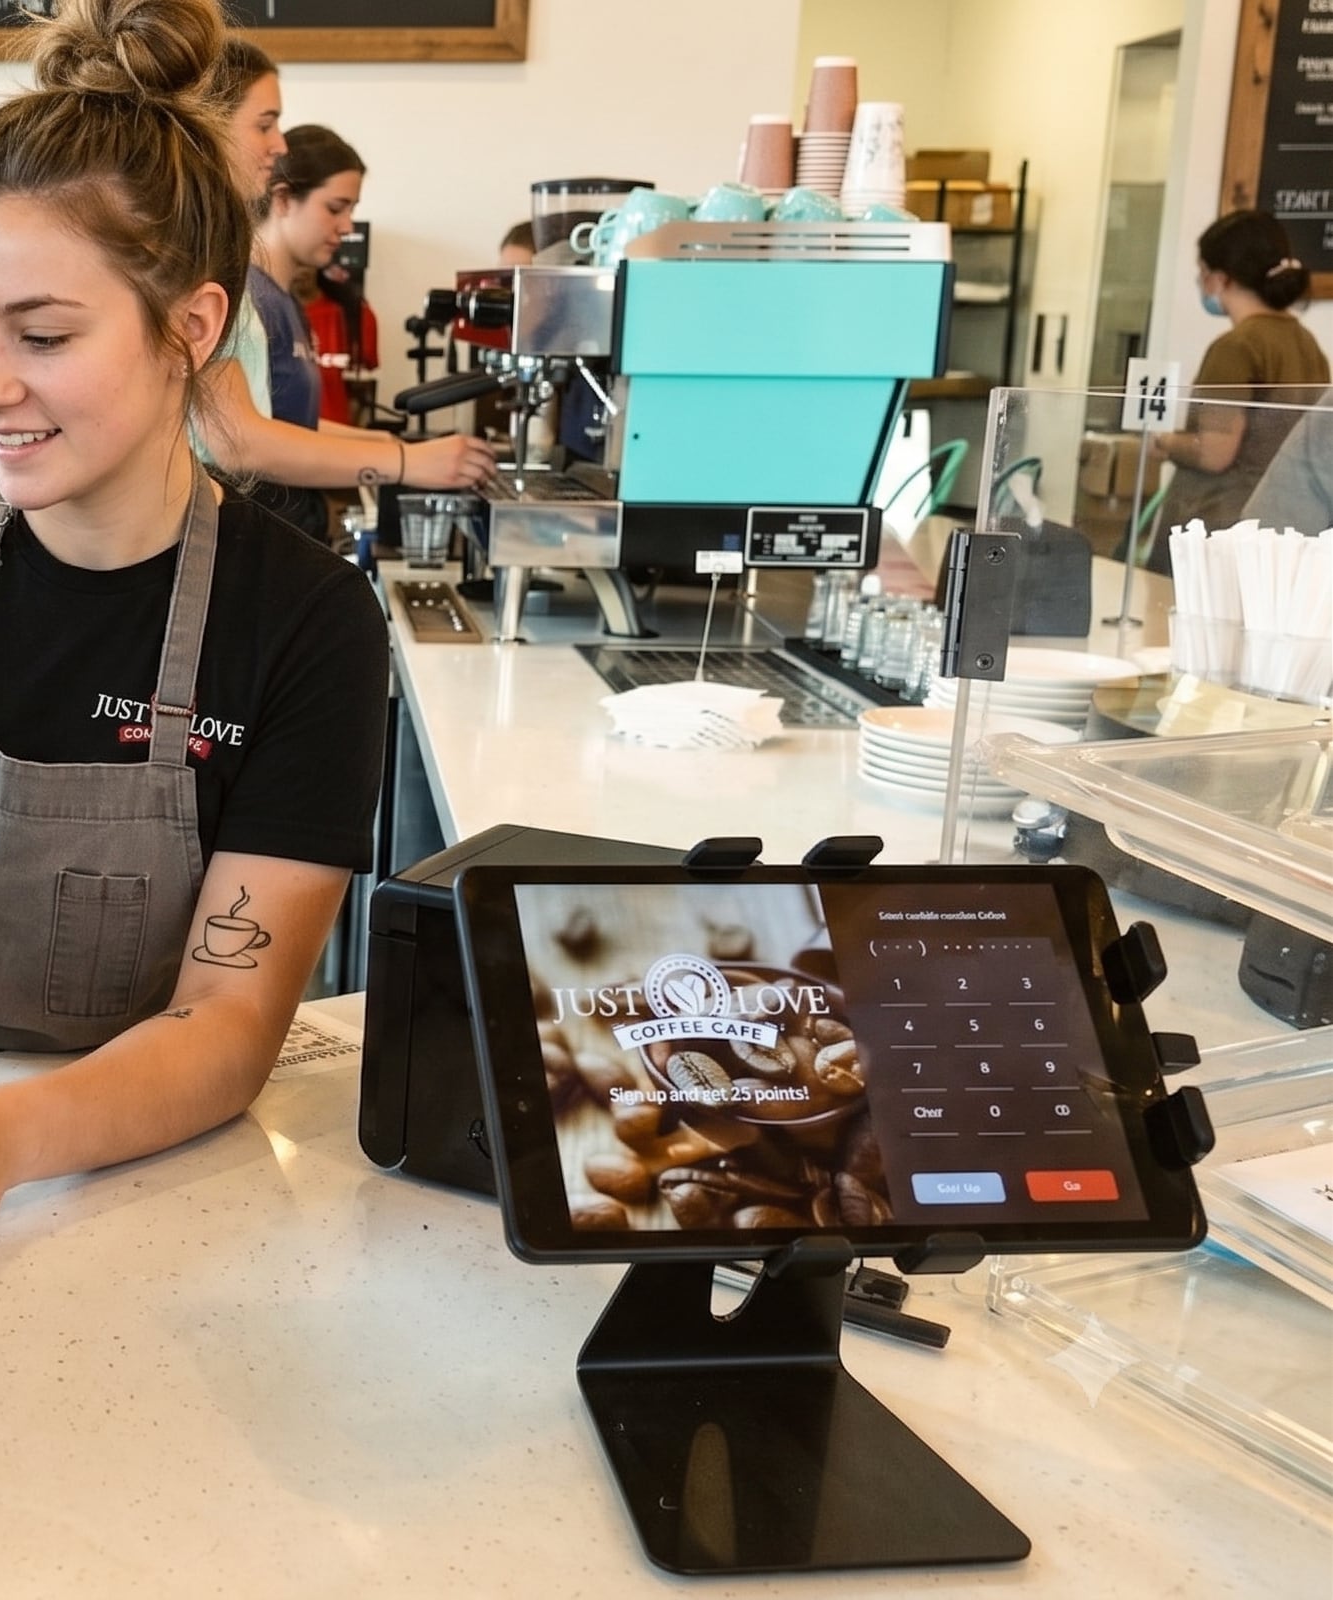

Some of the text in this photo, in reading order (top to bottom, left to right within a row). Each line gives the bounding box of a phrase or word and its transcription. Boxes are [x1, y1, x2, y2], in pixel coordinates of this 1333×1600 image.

[1138, 375, 1167, 421] 14
[91, 693, 245, 746] JUST LOVE
[893, 977, 1033, 991] 1 2 3
[551, 985, 830, 1024] JUST LOVE
[630, 1020, 763, 1042] COFFEE CAFE
[904, 1018, 1045, 1032] 4 5 6
[913, 1061, 1056, 1075] 7 8 9
[609, 1087, 645, 1105] Sign
[647, 1089, 666, 1105] up
[669, 1087, 698, 1102] and
[731, 1087, 751, 1102] 25
[755, 1086, 810, 1105] points!
[989, 1104, 1001, 1119] 0
